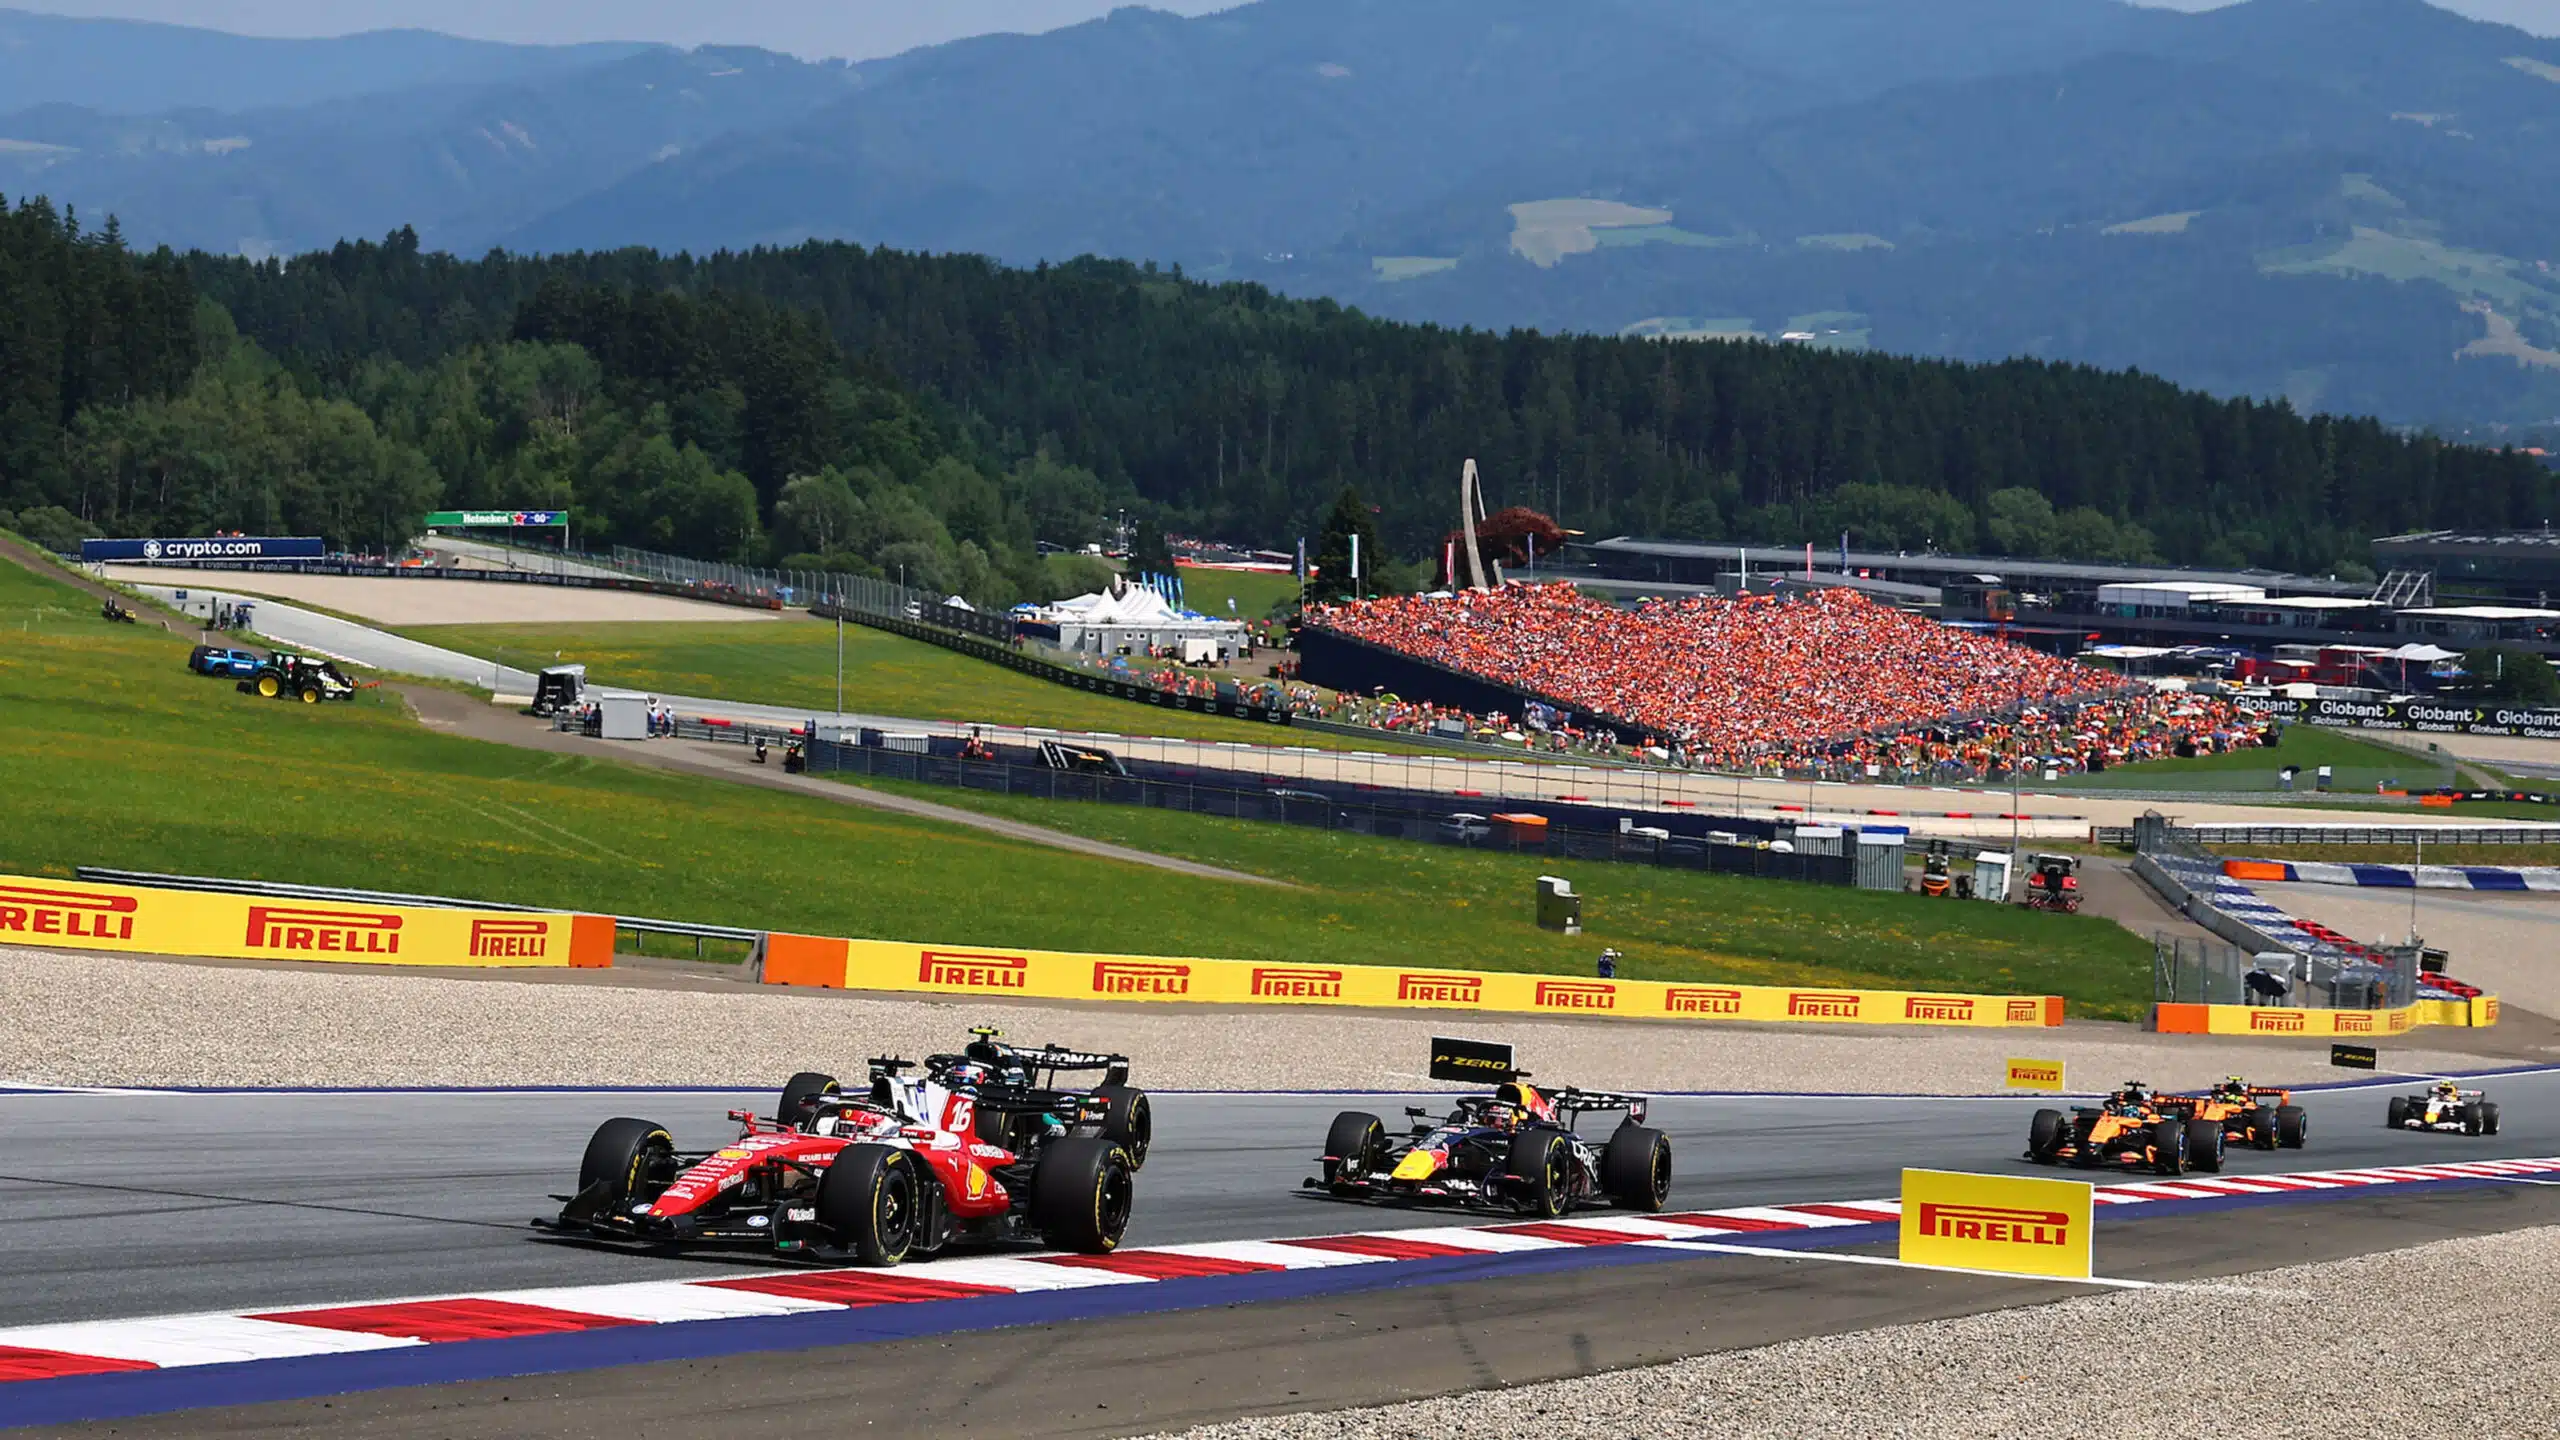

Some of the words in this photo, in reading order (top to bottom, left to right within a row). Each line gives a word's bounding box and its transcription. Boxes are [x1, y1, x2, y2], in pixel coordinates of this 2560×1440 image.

[463, 513, 509, 523] Heineken
[166, 541, 261, 557] crypto.com
[2233, 696, 2298, 712] Globant
[2320, 700, 2385, 717] Globant
[2407, 705, 2473, 722] Globant
[2310, 716, 2349, 726] Globant
[2363, 718, 2402, 729] Globant
[2416, 721, 2455, 732] Globant
[2469, 724, 2509, 735] Globant
[2523, 727, 2560, 738] Globan
[0, 885, 137, 940] RELLI
[246, 906, 403, 954] PIRELLI
[469, 919, 548, 957] PIRELLI
[918, 950, 1027, 988] PIRELLI
[1093, 961, 1190, 993] PIRELLI
[1251, 968, 1342, 997] PIRELLI
[1398, 974, 1482, 1002] PIRELLI
[1535, 981, 1616, 1009] PIRELLI
[1665, 988, 1741, 1013] PIRELLI
[1788, 993, 1860, 1017] PIRELLI
[1905, 997, 1974, 1020] PIRELLI
[2006, 1001, 2036, 1021] PIRELLI
[2251, 1011, 2304, 1031] PIRELLI
[2334, 1013, 2373, 1031] PIRELLI
[1434, 1054, 1449, 1063] P
[1452, 1056, 1508, 1070] ZERO
[2011, 1068, 2058, 1081] PIRELLI
[868, 1103, 898, 1118] DXC
[949, 1100, 974, 1132] 16
[1442, 1179, 1480, 1191] VISA
[1919, 1202, 2070, 1246] PIRELLI
